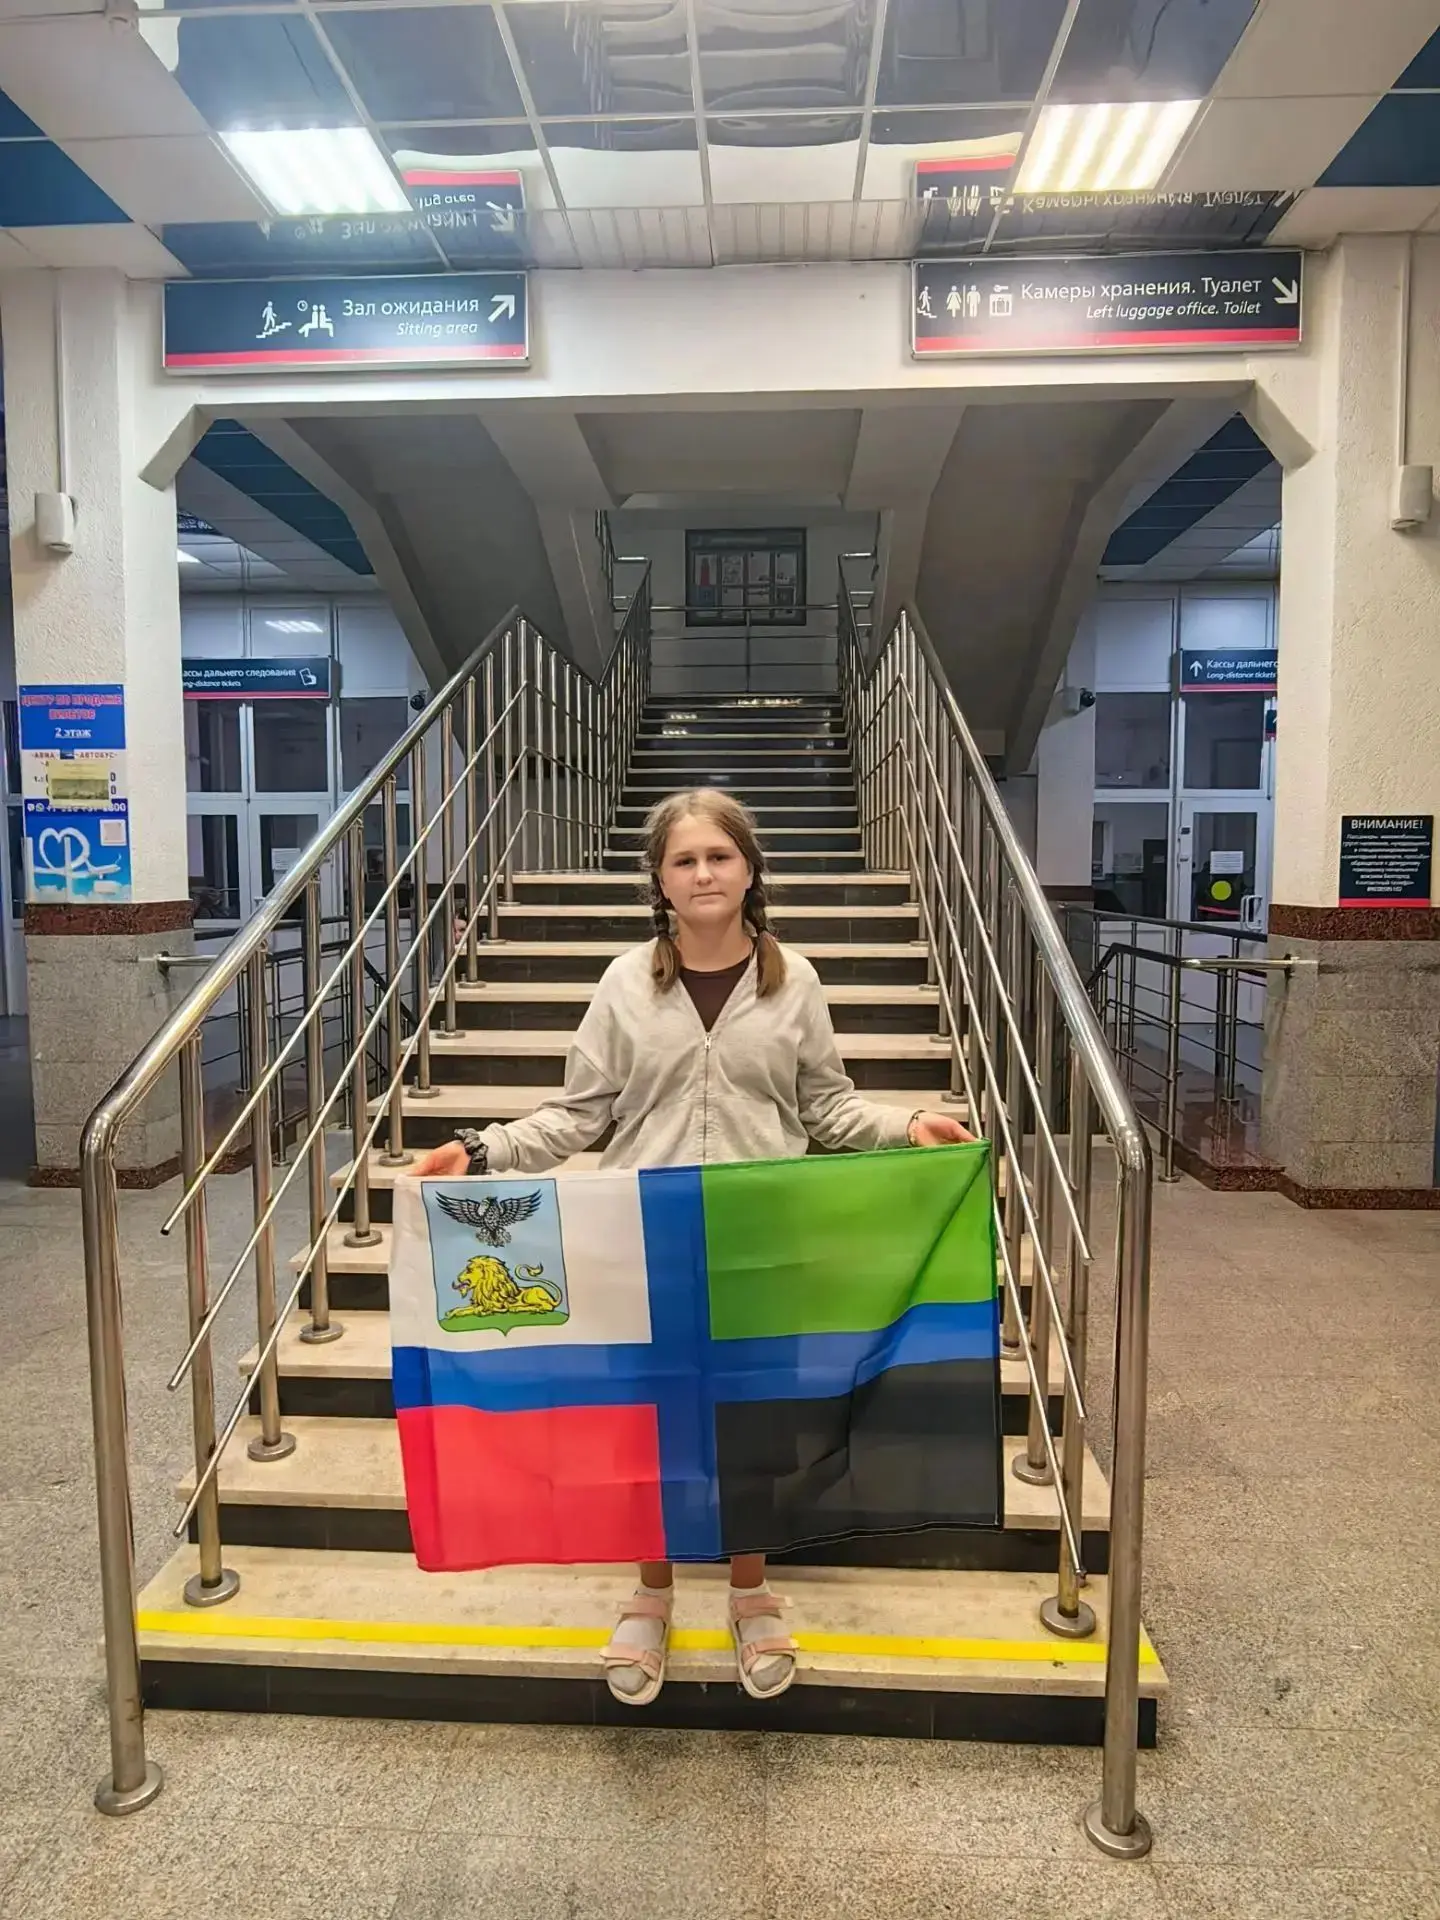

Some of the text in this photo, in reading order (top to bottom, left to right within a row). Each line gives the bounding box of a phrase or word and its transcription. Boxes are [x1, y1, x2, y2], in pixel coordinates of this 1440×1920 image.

[1020, 277, 1262, 304] Камеры хранения. Туалет
[342, 298, 479, 316] Зал ожидания
[1086, 301, 1261, 320] Left luggage office. Toilet
[396, 322, 478, 337] Sitting area
[1206, 659, 1235, 669] Кассы
[204, 669, 244, 678] дальнего
[245, 668, 297, 678] следования
[1206, 671, 1254, 680] Long-distance
[55, 727, 92, 738] 2 этаж
[1351, 819, 1424, 829] ВНИМАНИЕ!
